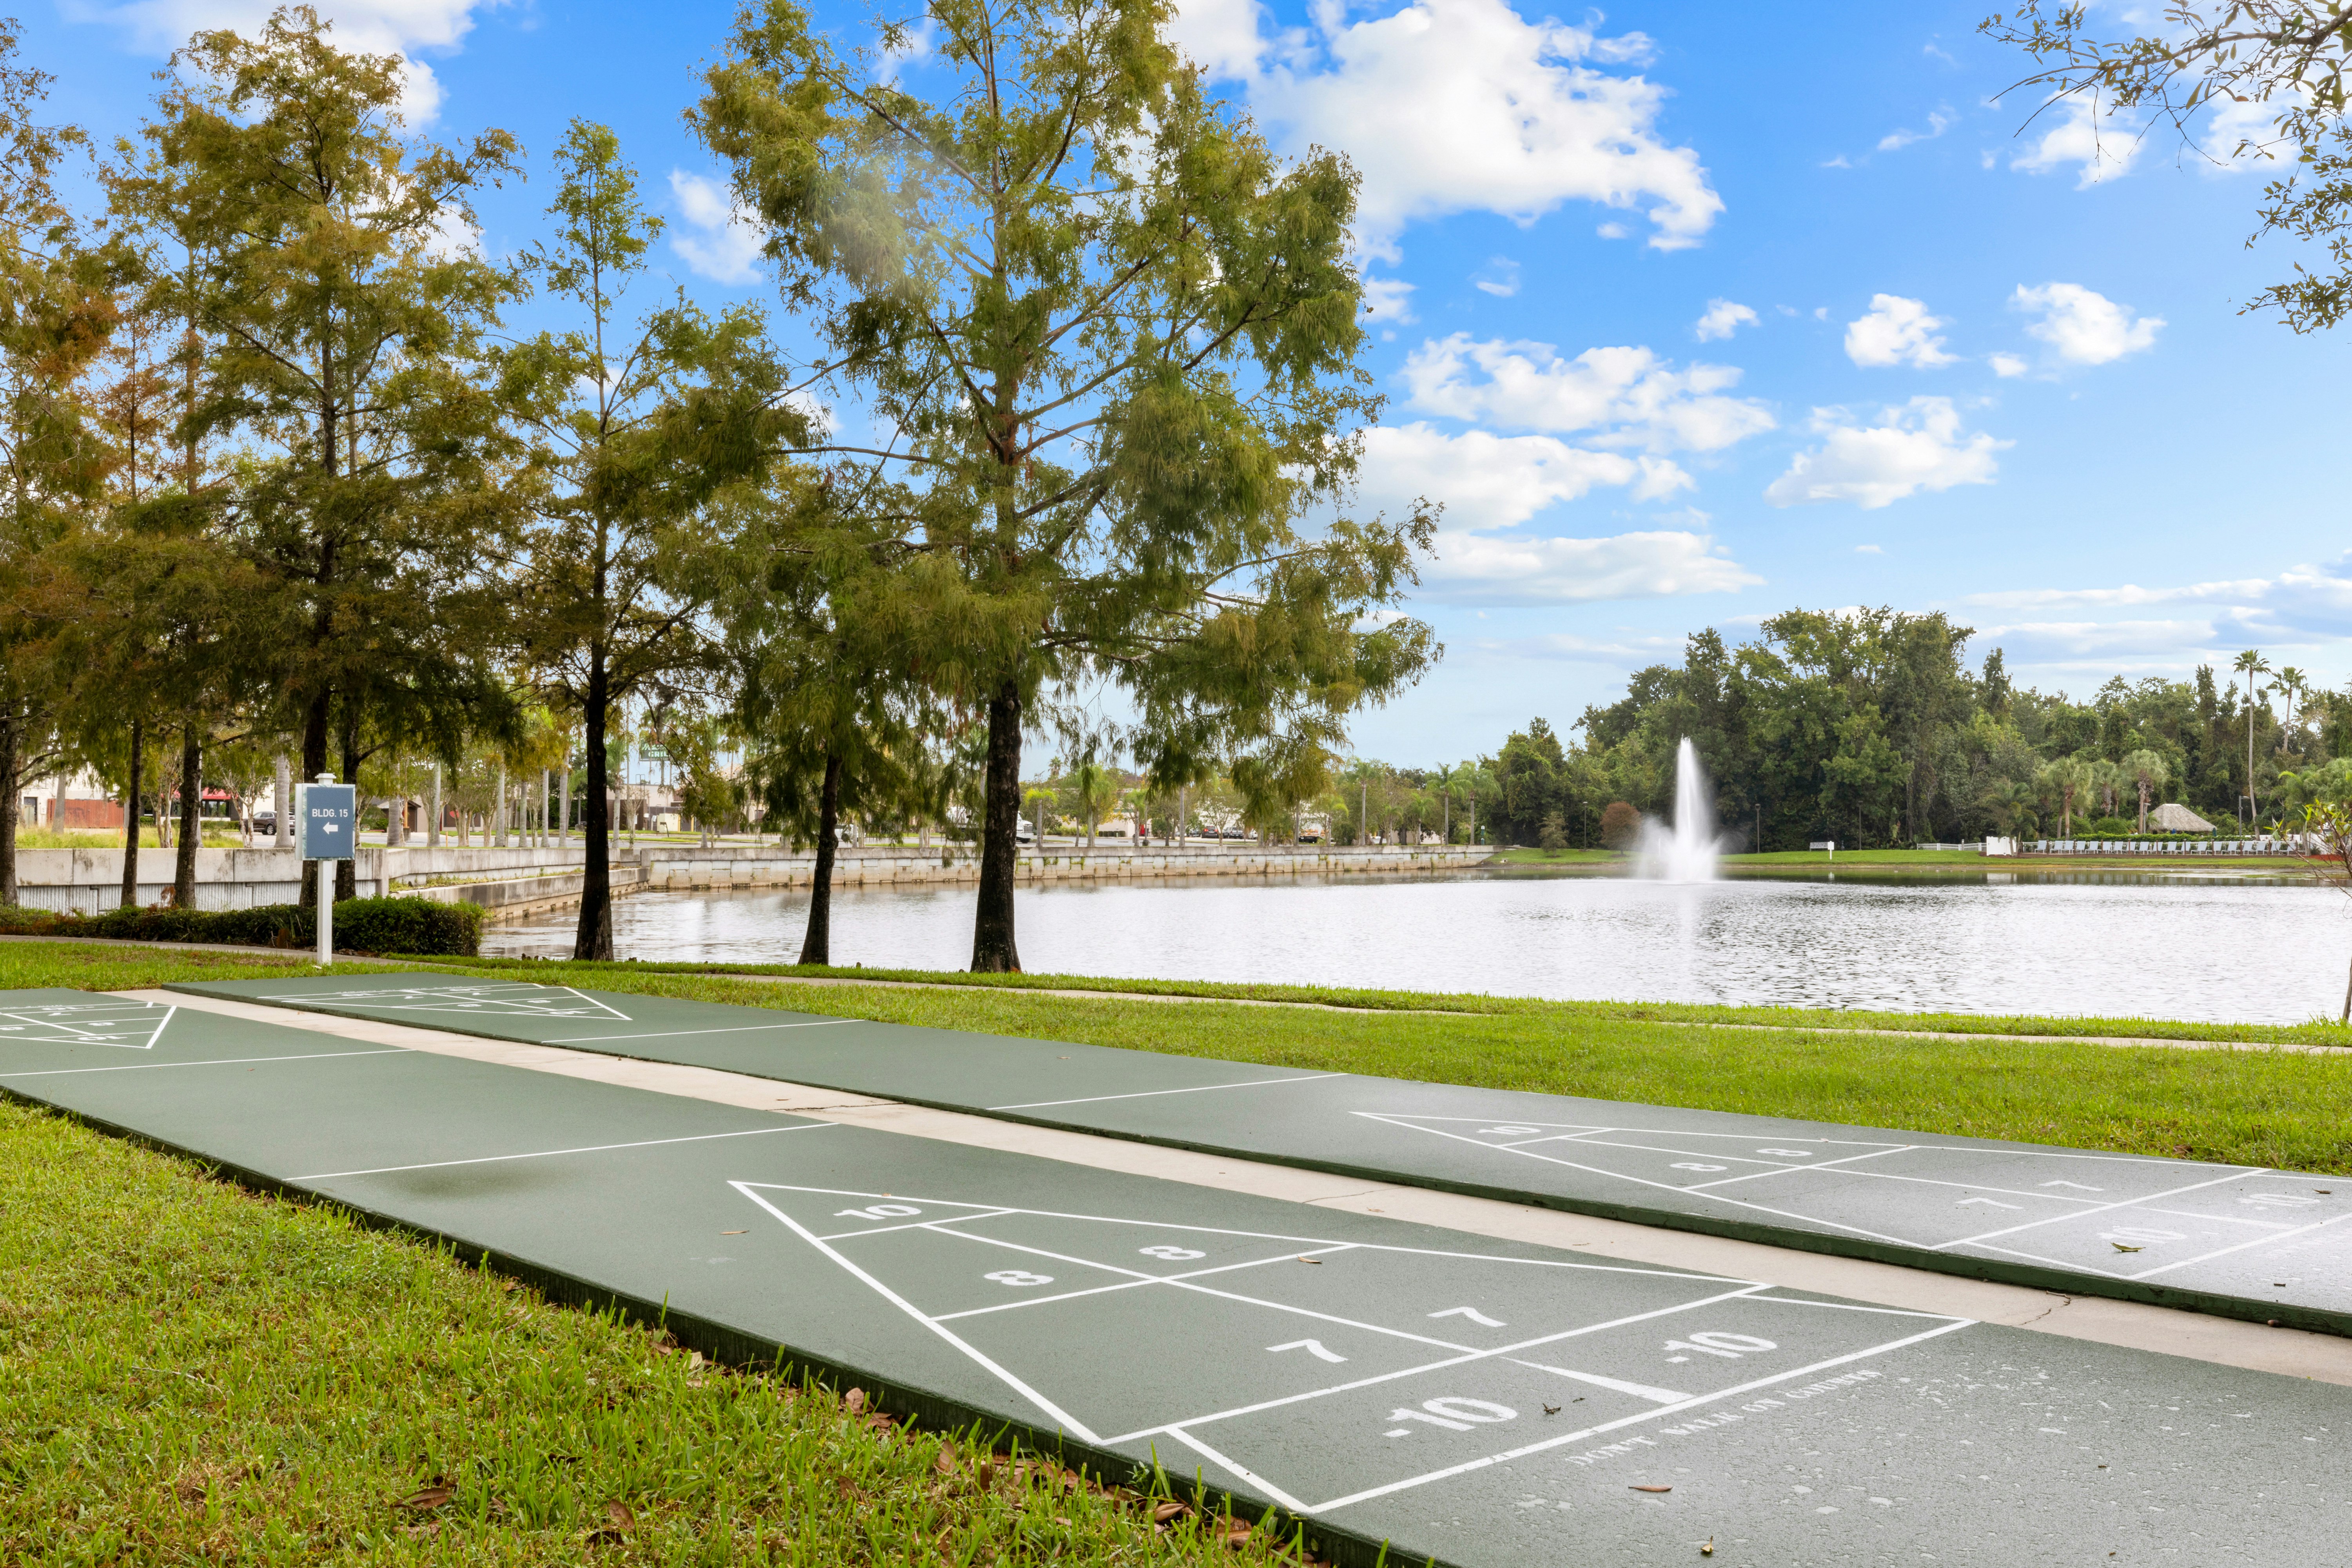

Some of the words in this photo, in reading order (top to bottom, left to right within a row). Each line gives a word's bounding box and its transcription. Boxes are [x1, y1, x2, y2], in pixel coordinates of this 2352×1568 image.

[312, 809, 337, 817] BLDG.
[339, 809, 348, 817] 15
[1476, 1126, 1541, 1135] 10
[1755, 1148, 1813, 1156] 8
[1670, 1162, 1728, 1172] 8
[2038, 1180, 2105, 1191] 7
[833, 1201, 922, 1220] 10
[1955, 1197, 2026, 1210] 7
[1138, 1245, 1207, 1260] 8
[984, 1270, 1054, 1286] 8
[1426, 1306, 1508, 1328] 7
[1265, 1339, 1349, 1363] 7
[1662, 1332, 1777, 1363] -10
[1381, 1397, 1518, 1438] -10
[1564, 1436, 1658, 1466] DON'T
[1659, 1412, 1745, 1436] WALK
[1741, 1394, 1786, 1412] ON
[1785, 1369, 1882, 1399] COURTS
